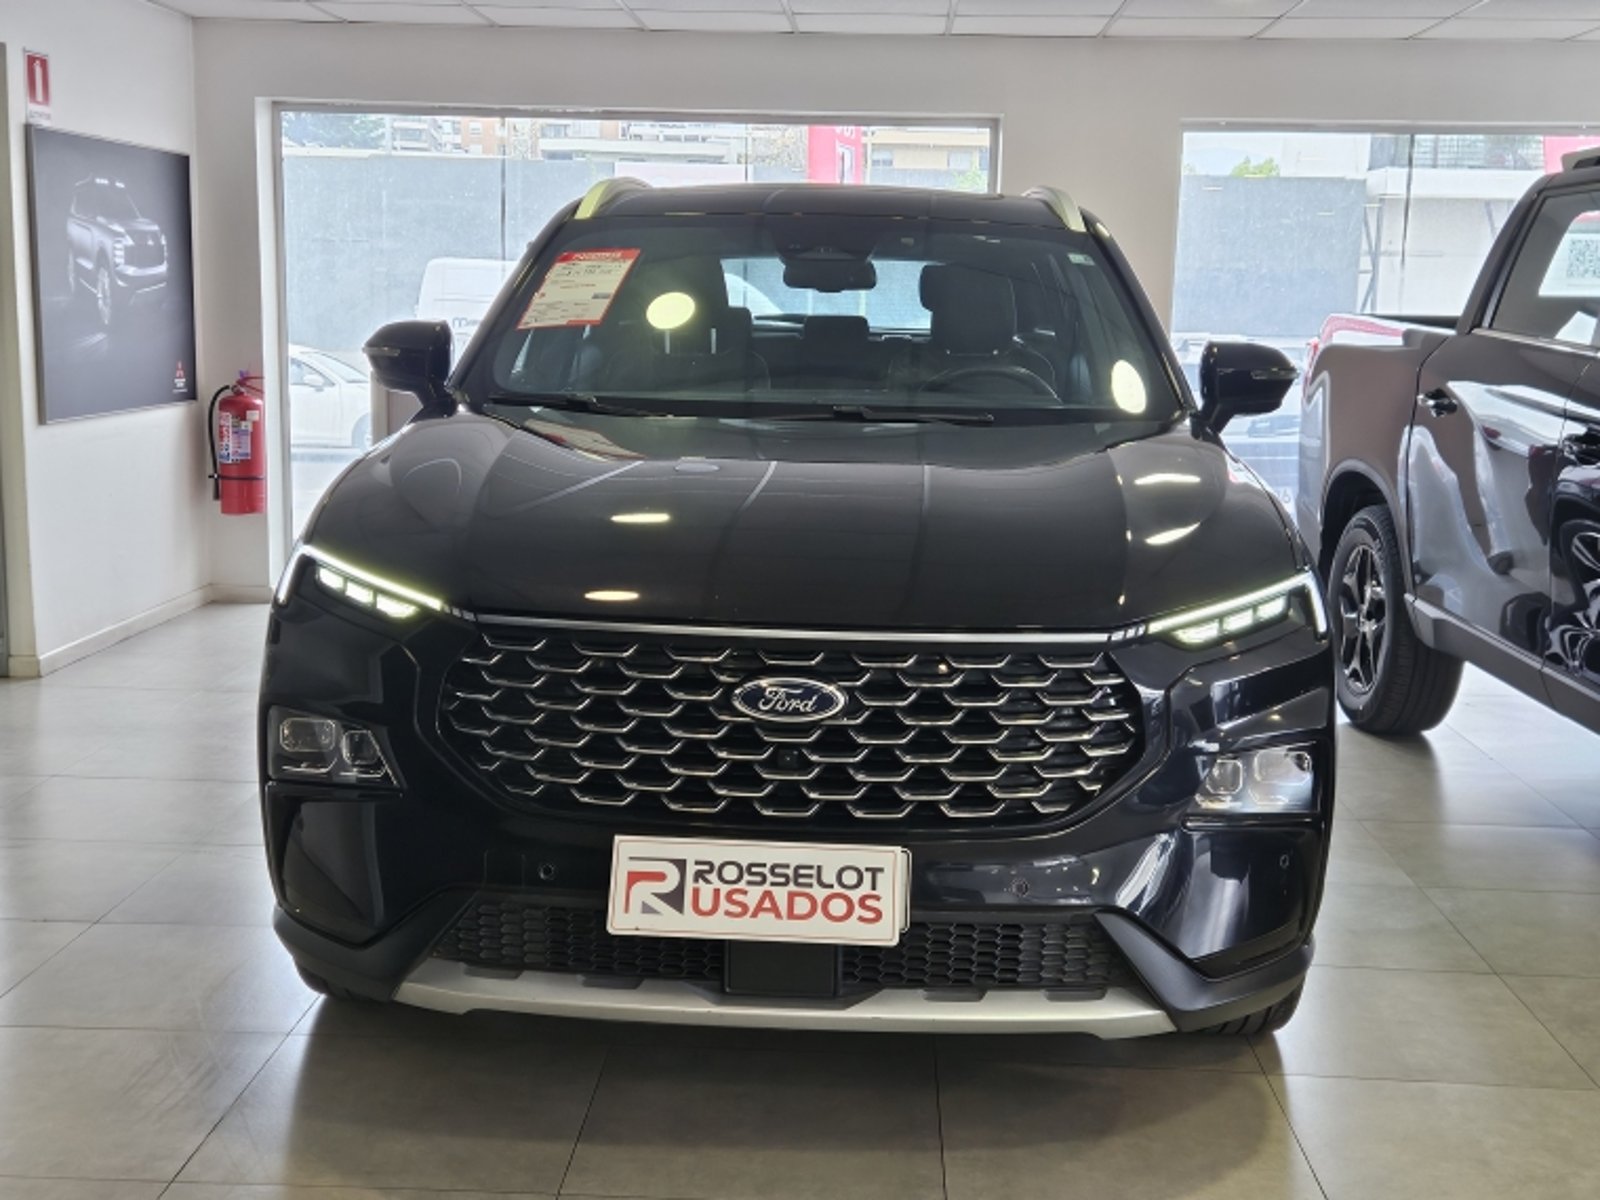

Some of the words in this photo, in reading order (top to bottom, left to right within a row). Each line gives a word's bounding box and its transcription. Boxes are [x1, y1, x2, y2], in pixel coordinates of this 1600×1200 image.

[758, 687, 819, 712] Ford
[693, 860, 885, 891] ROSSELOT
[691, 888, 884, 924] USADOS
